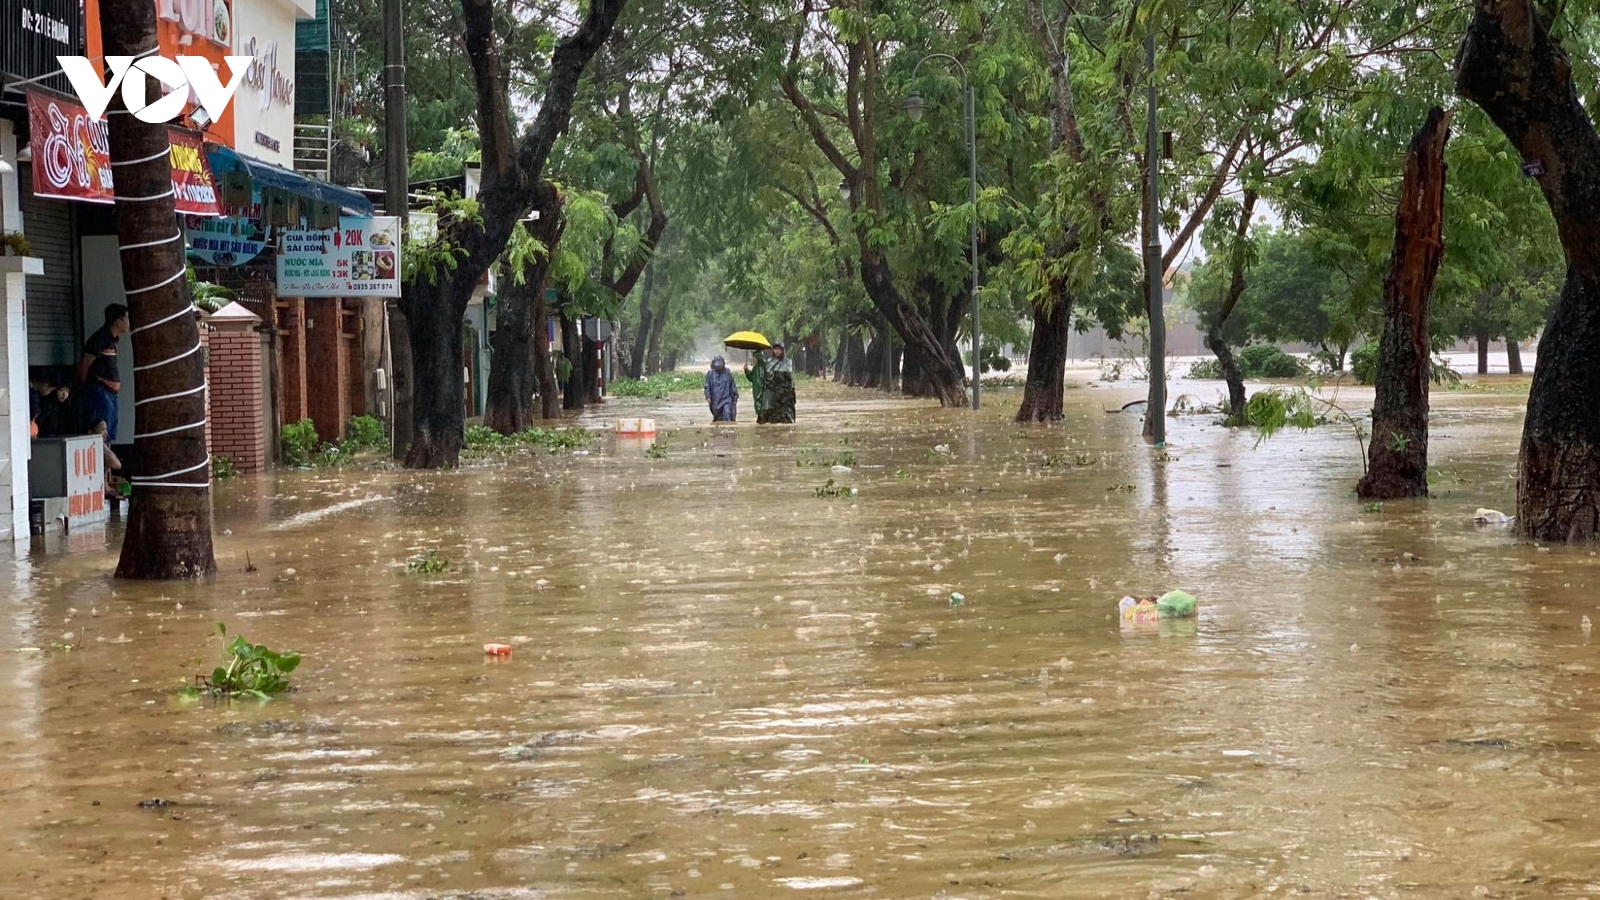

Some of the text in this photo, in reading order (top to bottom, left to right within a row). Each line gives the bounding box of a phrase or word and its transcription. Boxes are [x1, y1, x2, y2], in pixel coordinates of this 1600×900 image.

[345, 229, 363, 246] 20K
[336, 259, 348, 267] 5K
[332, 270, 349, 278] 13K
